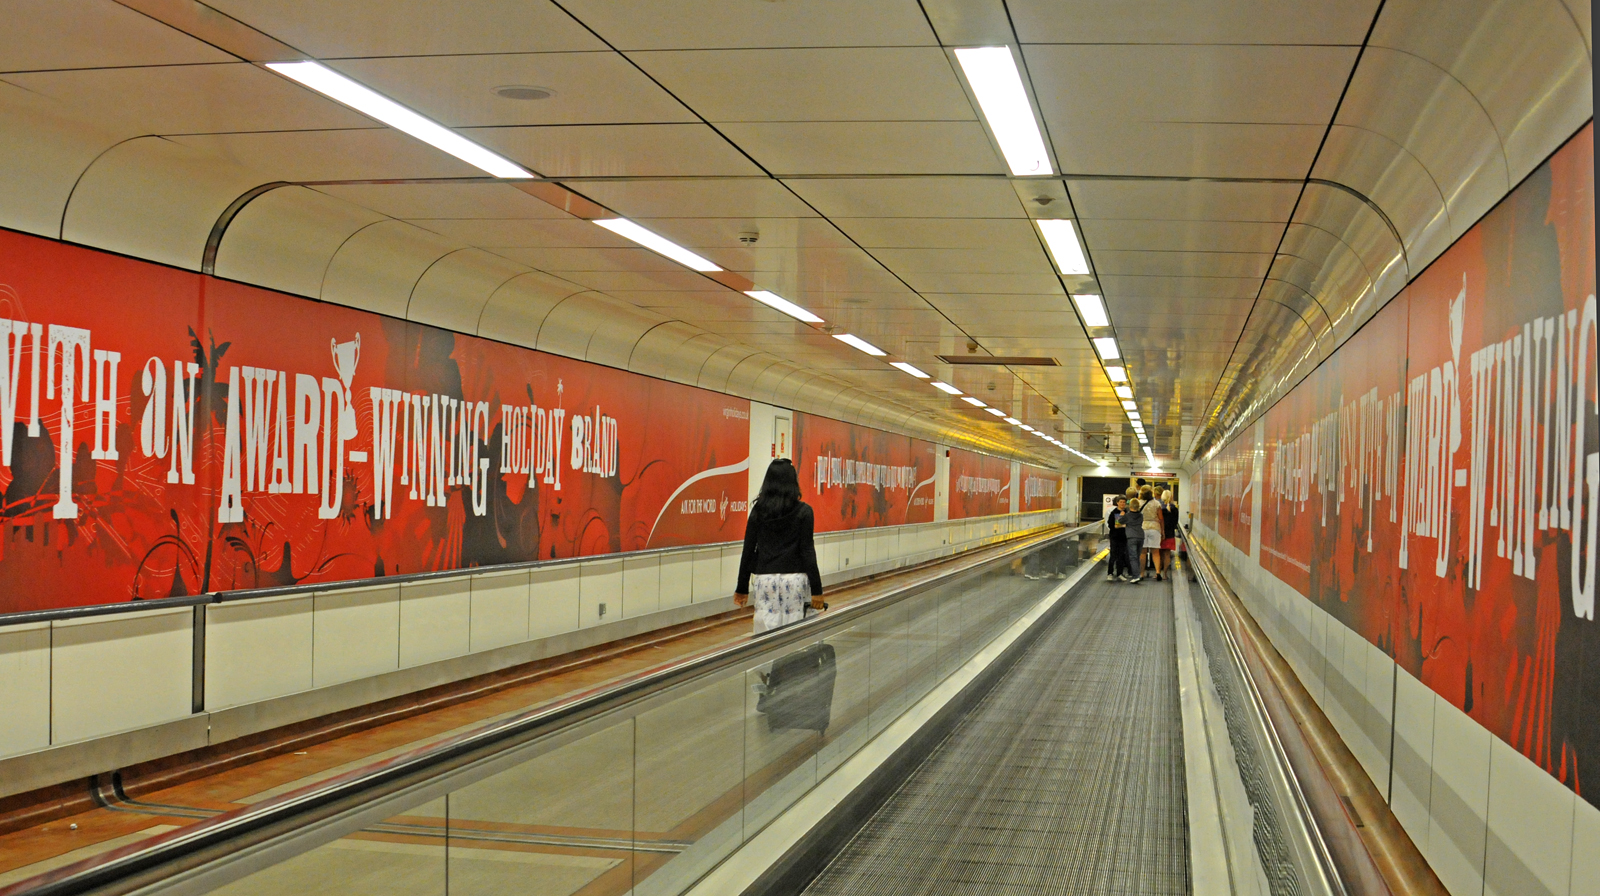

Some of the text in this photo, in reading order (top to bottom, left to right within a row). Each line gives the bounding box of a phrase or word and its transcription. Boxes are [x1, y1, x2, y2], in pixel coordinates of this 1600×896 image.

[218, 364, 490, 524] AWARD-WINNING
[499, 403, 566, 491] HOLIDAY
[570, 404, 618, 478] BRAND
